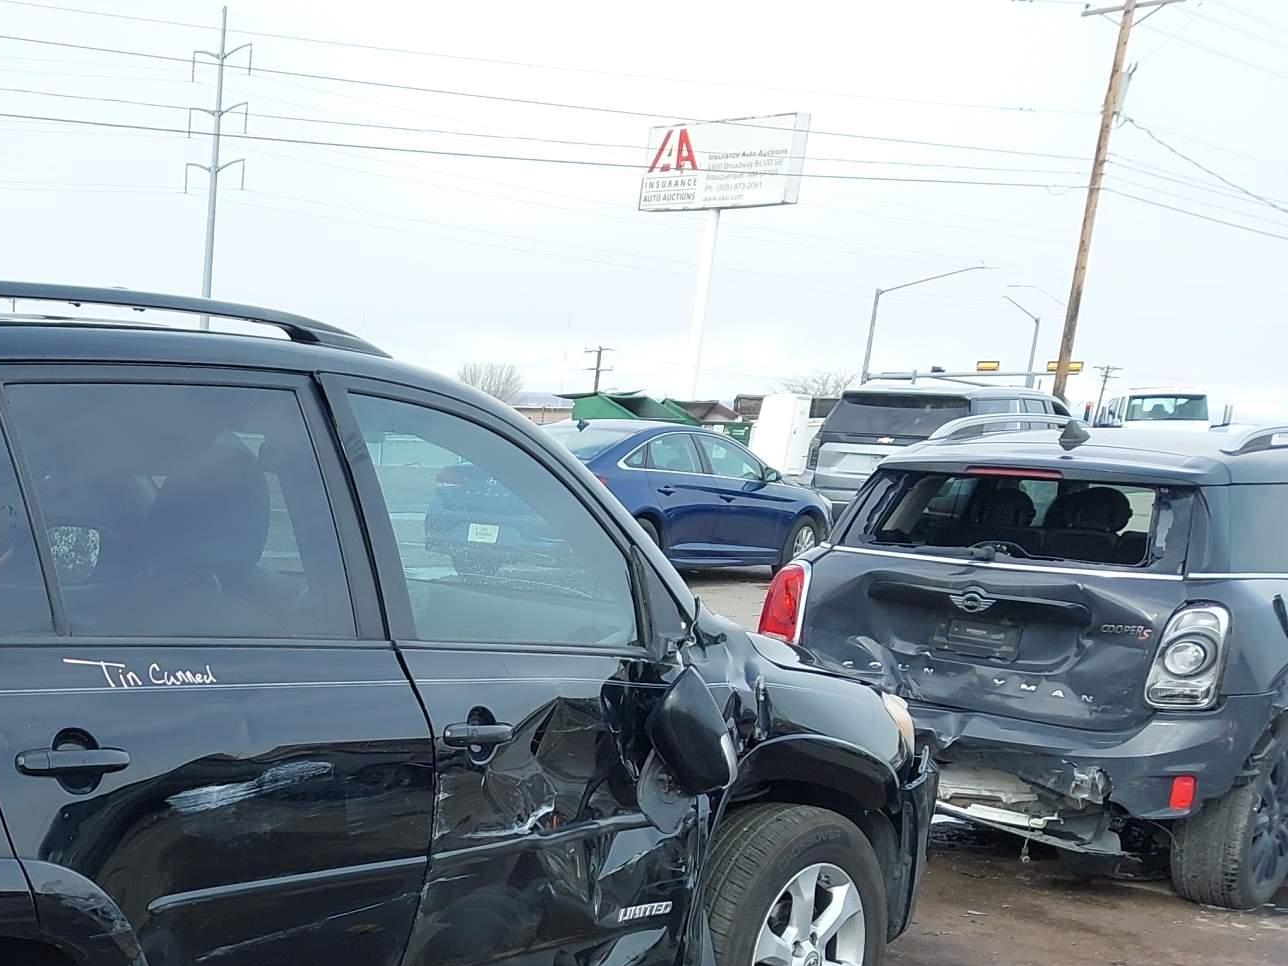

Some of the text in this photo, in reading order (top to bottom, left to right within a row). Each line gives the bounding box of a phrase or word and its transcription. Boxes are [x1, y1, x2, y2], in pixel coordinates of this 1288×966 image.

[644, 177, 698, 189] INSURANCE
[643, 191, 696, 203] AUTO AUCTIONS
[63, 657, 143, 689] Tin
[617, 901, 673, 922] LIMITED
